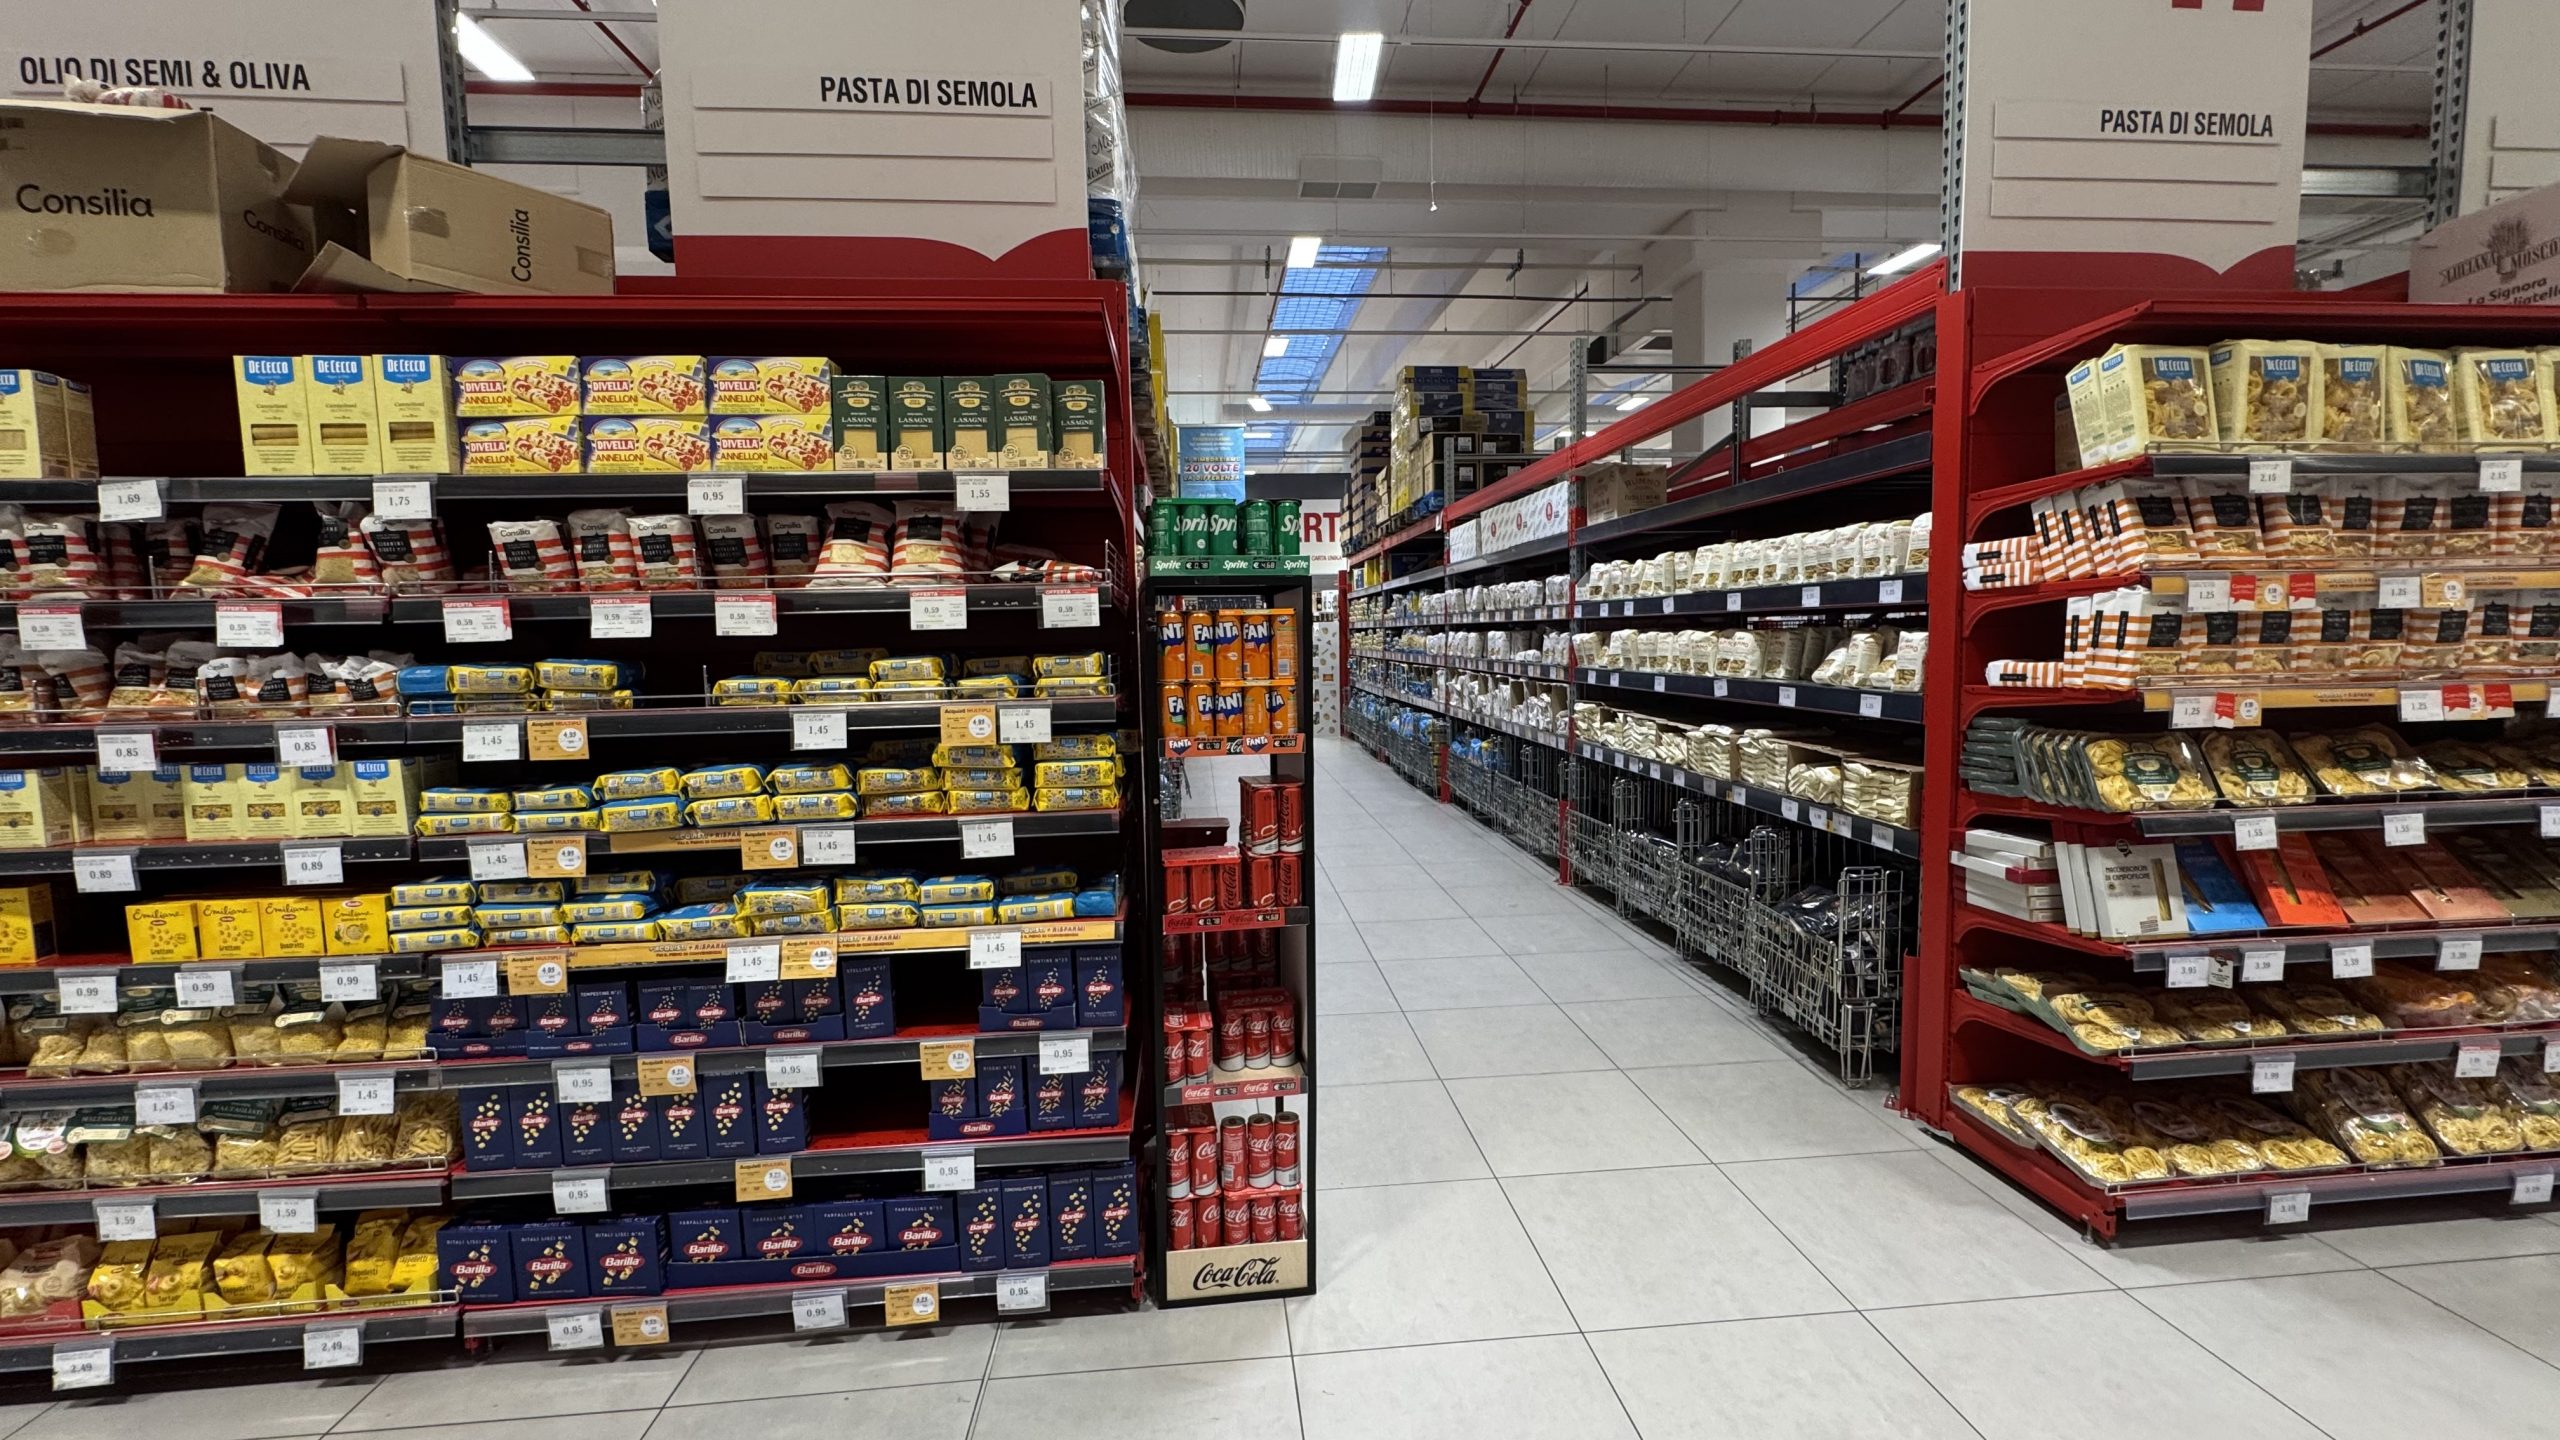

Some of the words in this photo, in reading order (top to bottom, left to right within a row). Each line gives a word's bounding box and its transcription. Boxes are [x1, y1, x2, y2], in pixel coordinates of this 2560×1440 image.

[20, 57, 81, 85] OLIO
[91, 58, 117, 86] DI
[126, 60, 192, 87] SEMI
[202, 60, 221, 87] &
[229, 61, 311, 91] OLIVA
[820, 76, 900, 104] PASTA
[906, 79, 930, 105] DI
[937, 81, 1038, 108] SEMOLA
[2100, 109, 2164, 135] PASTA
[2169, 111, 2188, 135] DI
[2194, 112, 2273, 138] SEMOLA
[16, 183, 154, 218] Consilia
[243, 209, 305, 252] Consilia
[511, 208, 531, 283] Consilia
[2490, 278, 2547, 302] Signora
[465, 381, 503, 392] DIVELLA
[592, 381, 630, 392] DIVELLA
[719, 380, 757, 391] DIVELLA
[841, 416, 877, 424] LASAGNE
[898, 416, 933, 424] LASAGNE
[953, 416, 988, 424] LASAGNE
[1004, 414, 1037, 422] LASAGNE
[1061, 418, 1094, 426] LASAGNE
[470, 441, 506, 452] DIVELLA
[597, 440, 634, 451] DIVELLA
[722, 439, 760, 450] DIVELLA
[1185, 464, 1199, 472] 20
[1204, 463, 1239, 472] VOLTE
[1155, 560, 1181, 570] Sprite
[1223, 560, 1248, 569] Sprite
[1283, 560, 1308, 569] Sprite
[1169, 738, 1191, 749] FANTA
[1246, 736, 1268, 748] FANTA
[203, 905, 253, 917] Emiliane
[265, 903, 315, 915] Emiliane
[333, 909, 374, 919] Emiliane
[132, 908, 185, 922] Emiliane
[672, 1033, 705, 1044] Barilla
[777, 1029, 808, 1038] Barilla
[963, 1123, 993, 1133] Barilla
[903, 1230, 938, 1240] Barilla
[762, 1240, 798, 1250] Barilla
[833, 1236, 869, 1246] Barilla
[688, 1244, 724, 1254] Barilla
[532, 1261, 568, 1271] Barilla
[606, 1256, 641, 1267] Barilla
[456, 1264, 492, 1275] Barilla
[796, 1264, 832, 1275] Barilla
